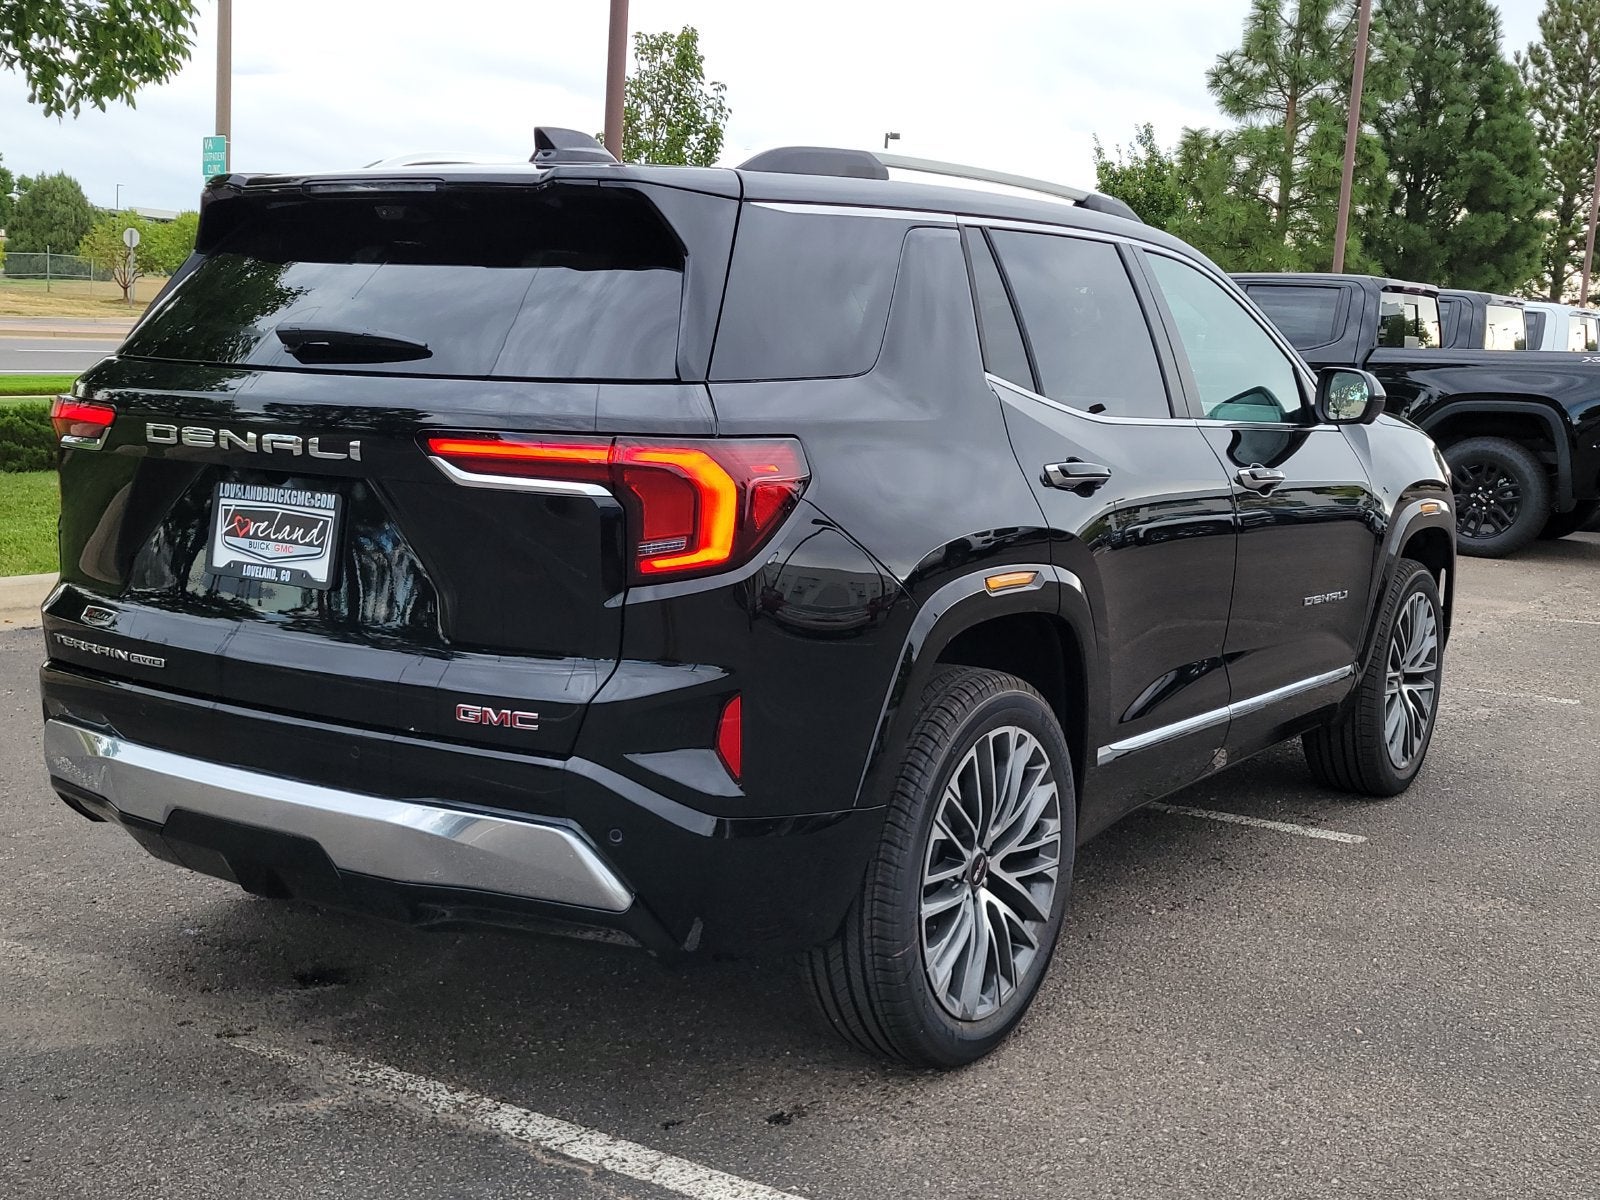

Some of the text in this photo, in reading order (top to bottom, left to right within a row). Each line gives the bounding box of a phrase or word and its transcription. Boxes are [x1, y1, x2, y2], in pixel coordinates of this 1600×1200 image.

[204, 138, 213, 150] VA
[146, 422, 362, 462] DENALI
[219, 482, 336, 510] LOVELANDBUICKGMC.COM
[222, 504, 325, 545] Loveland
[248, 540, 294, 554] BUICK GMC
[242, 564, 291, 582] LOVELAND, CO
[1304, 590, 1348, 606] DENALI
[53, 632, 165, 668] TERRAIN AWD
[456, 703, 539, 731] GMC
